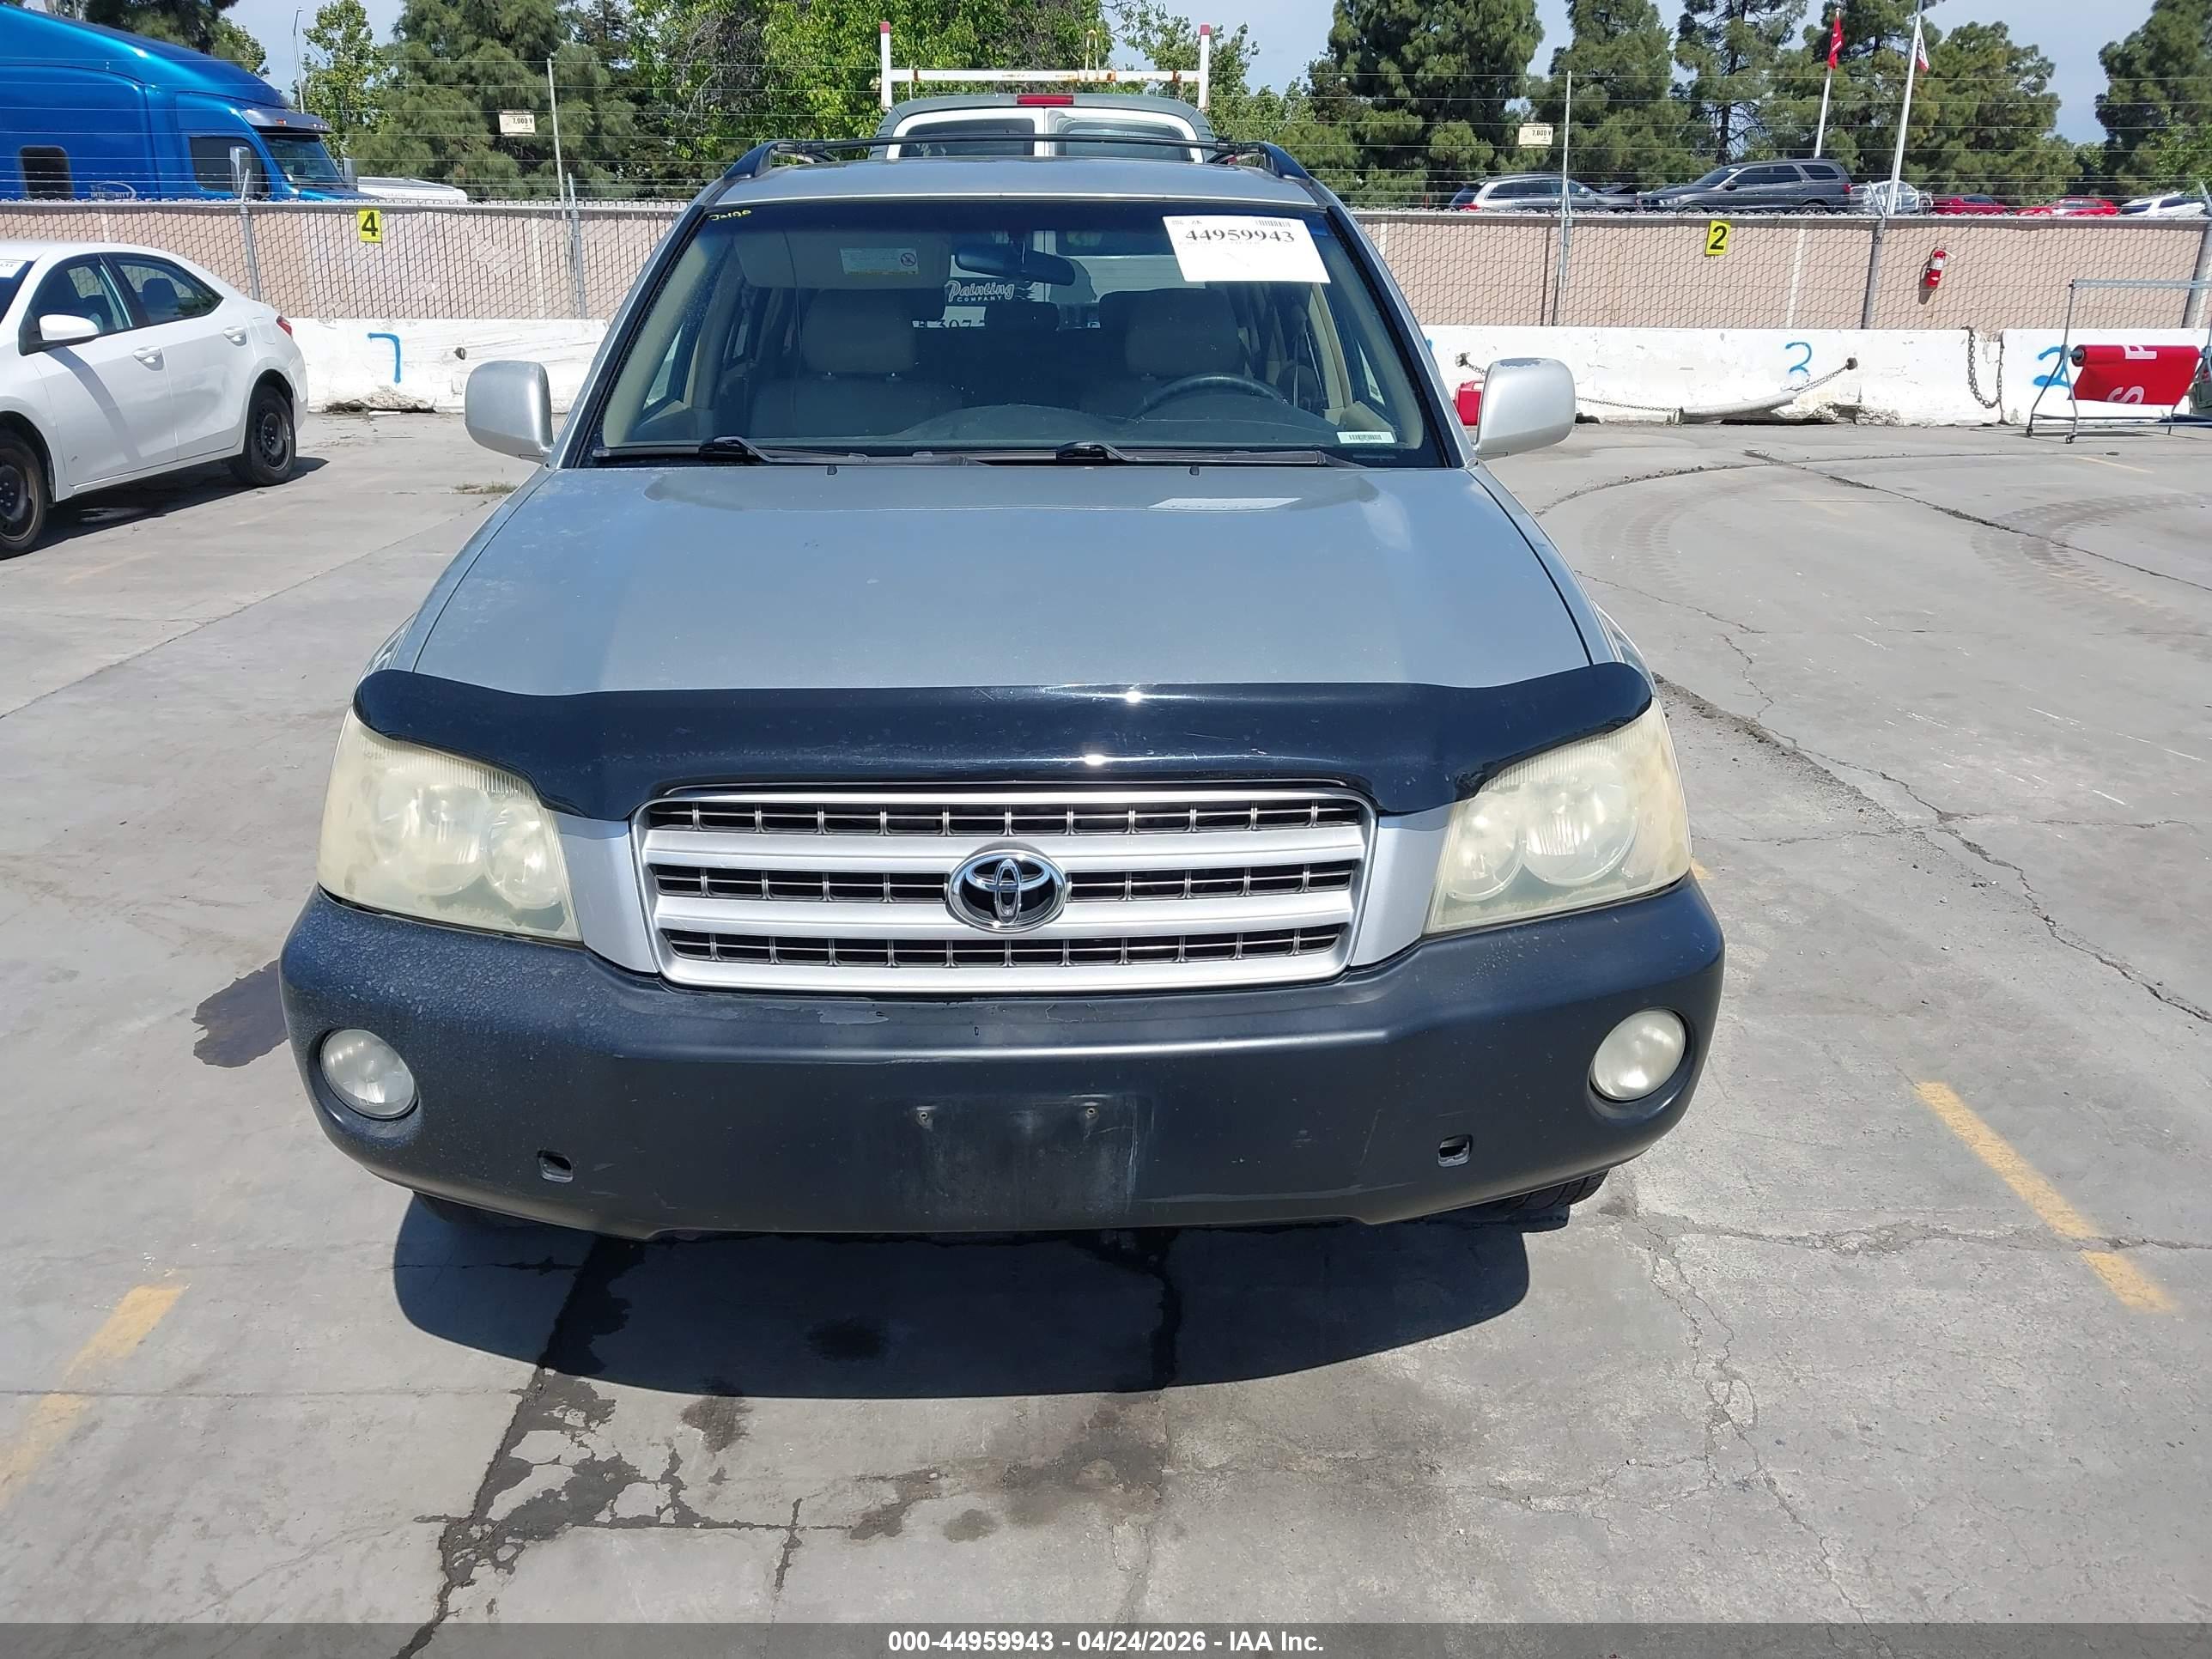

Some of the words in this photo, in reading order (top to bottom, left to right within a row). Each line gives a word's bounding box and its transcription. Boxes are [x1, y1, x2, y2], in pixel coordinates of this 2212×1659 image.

[361, 211, 378, 237] 4
[1185, 228, 1295, 242] 44959943
[1710, 225, 1728, 250] 2
[944, 281, 1014, 302] Painting
